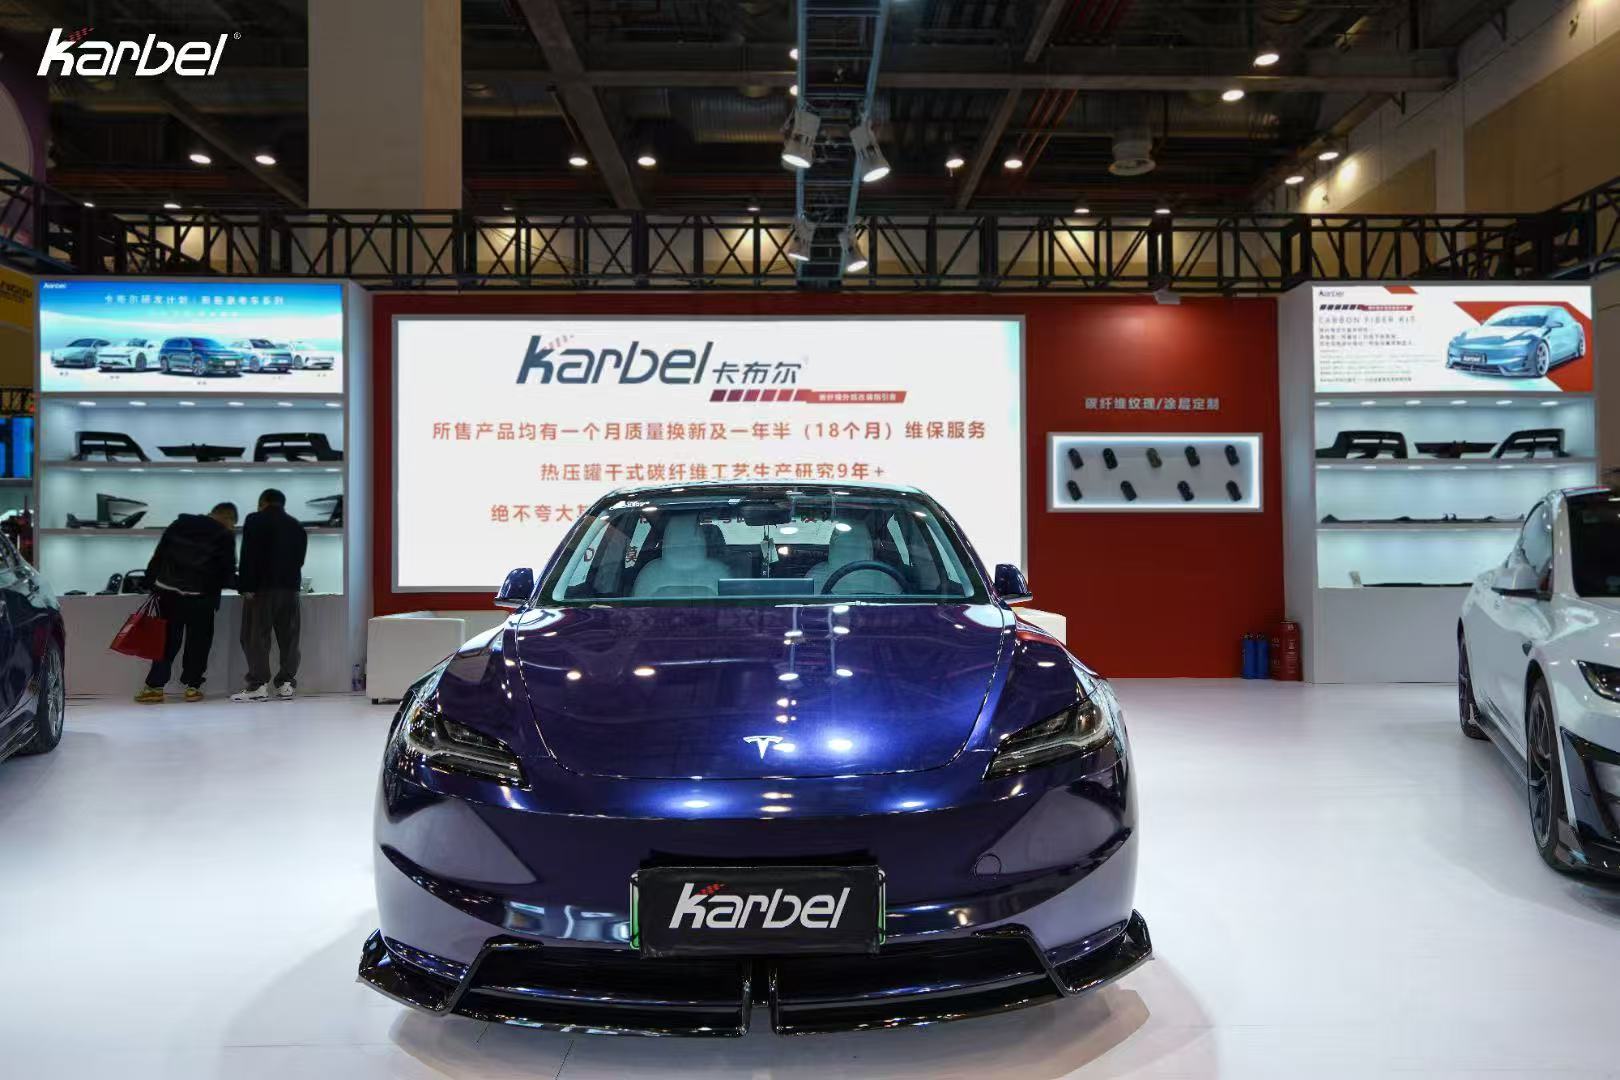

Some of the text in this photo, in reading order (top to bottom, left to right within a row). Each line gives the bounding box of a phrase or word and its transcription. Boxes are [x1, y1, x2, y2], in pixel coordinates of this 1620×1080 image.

[711, 361, 802, 384] 卡布尔
[1085, 397, 1220, 411] 碳纤维纹理/涂层定制
